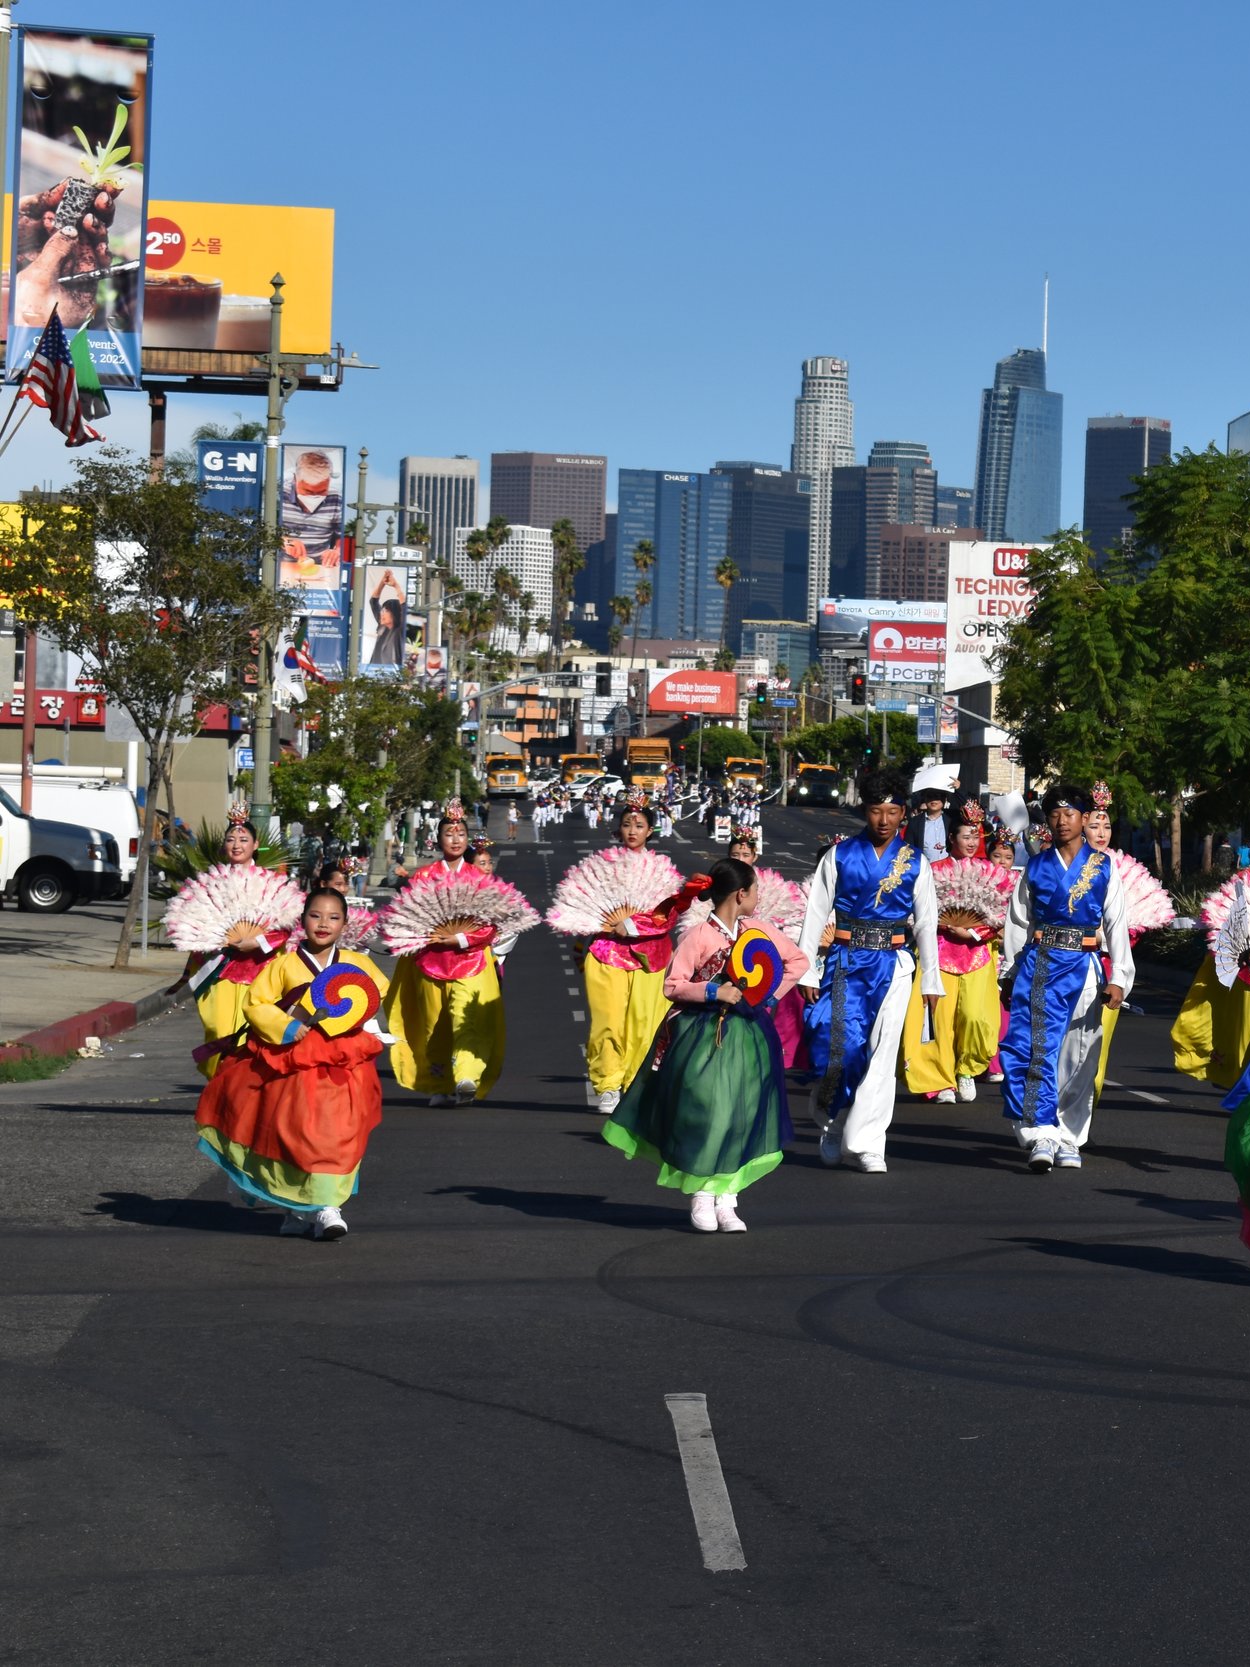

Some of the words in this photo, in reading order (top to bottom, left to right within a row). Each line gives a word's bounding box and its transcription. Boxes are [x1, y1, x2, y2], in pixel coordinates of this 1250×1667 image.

[190, 237, 222, 255] 스몰
[100, 353, 124, 364] 2022
[664, 474, 689, 482] CHASE
[868, 607, 896, 618] Camry
[955, 644, 986, 653] AUDIO
[892, 667, 923, 680] PCB
[665, 682, 676, 691] We
[677, 683, 694, 692] make
[694, 684, 721, 694] business
[665, 692, 690, 704] banking
[691, 694, 717, 704] personal
